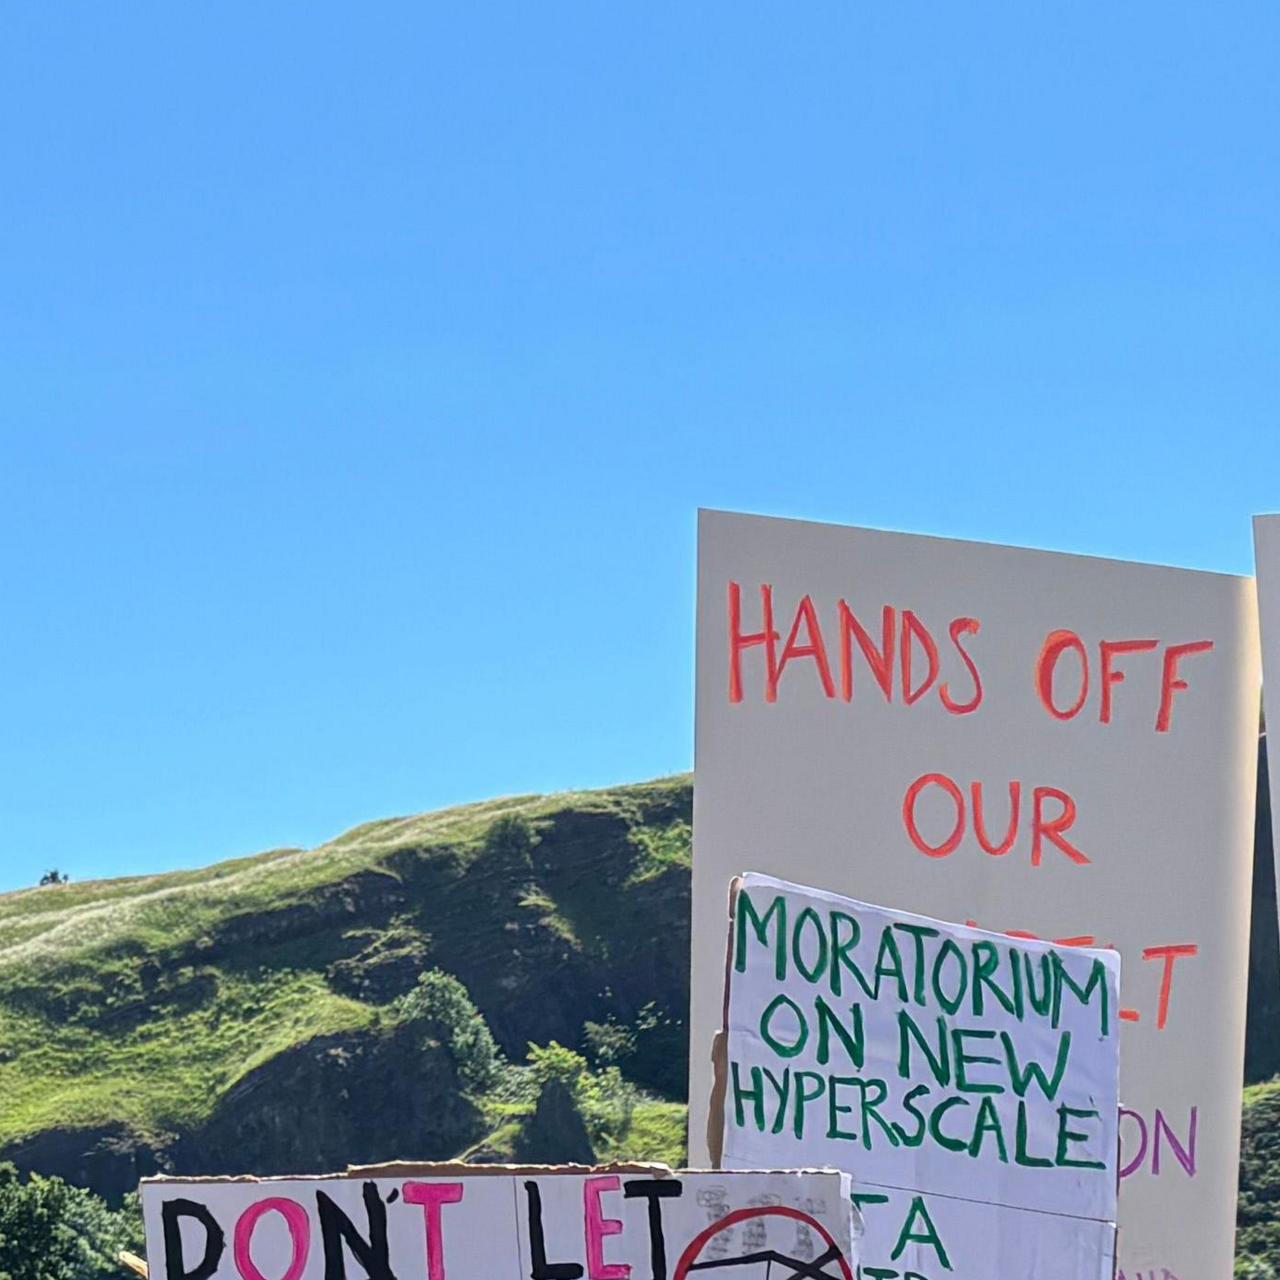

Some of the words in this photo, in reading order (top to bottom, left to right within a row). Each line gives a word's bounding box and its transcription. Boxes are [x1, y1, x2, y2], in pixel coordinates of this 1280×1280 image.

[728, 580, 983, 716] HANDS
[1035, 628, 1214, 733] OFF
[902, 772, 1091, 867] OUR
[734, 889, 1110, 1042] MORATORIUM
[760, 993, 865, 1070] ON
[898, 1008, 1071, 1102] NEW
[730, 1061, 1107, 1171] HYPERSCALE
